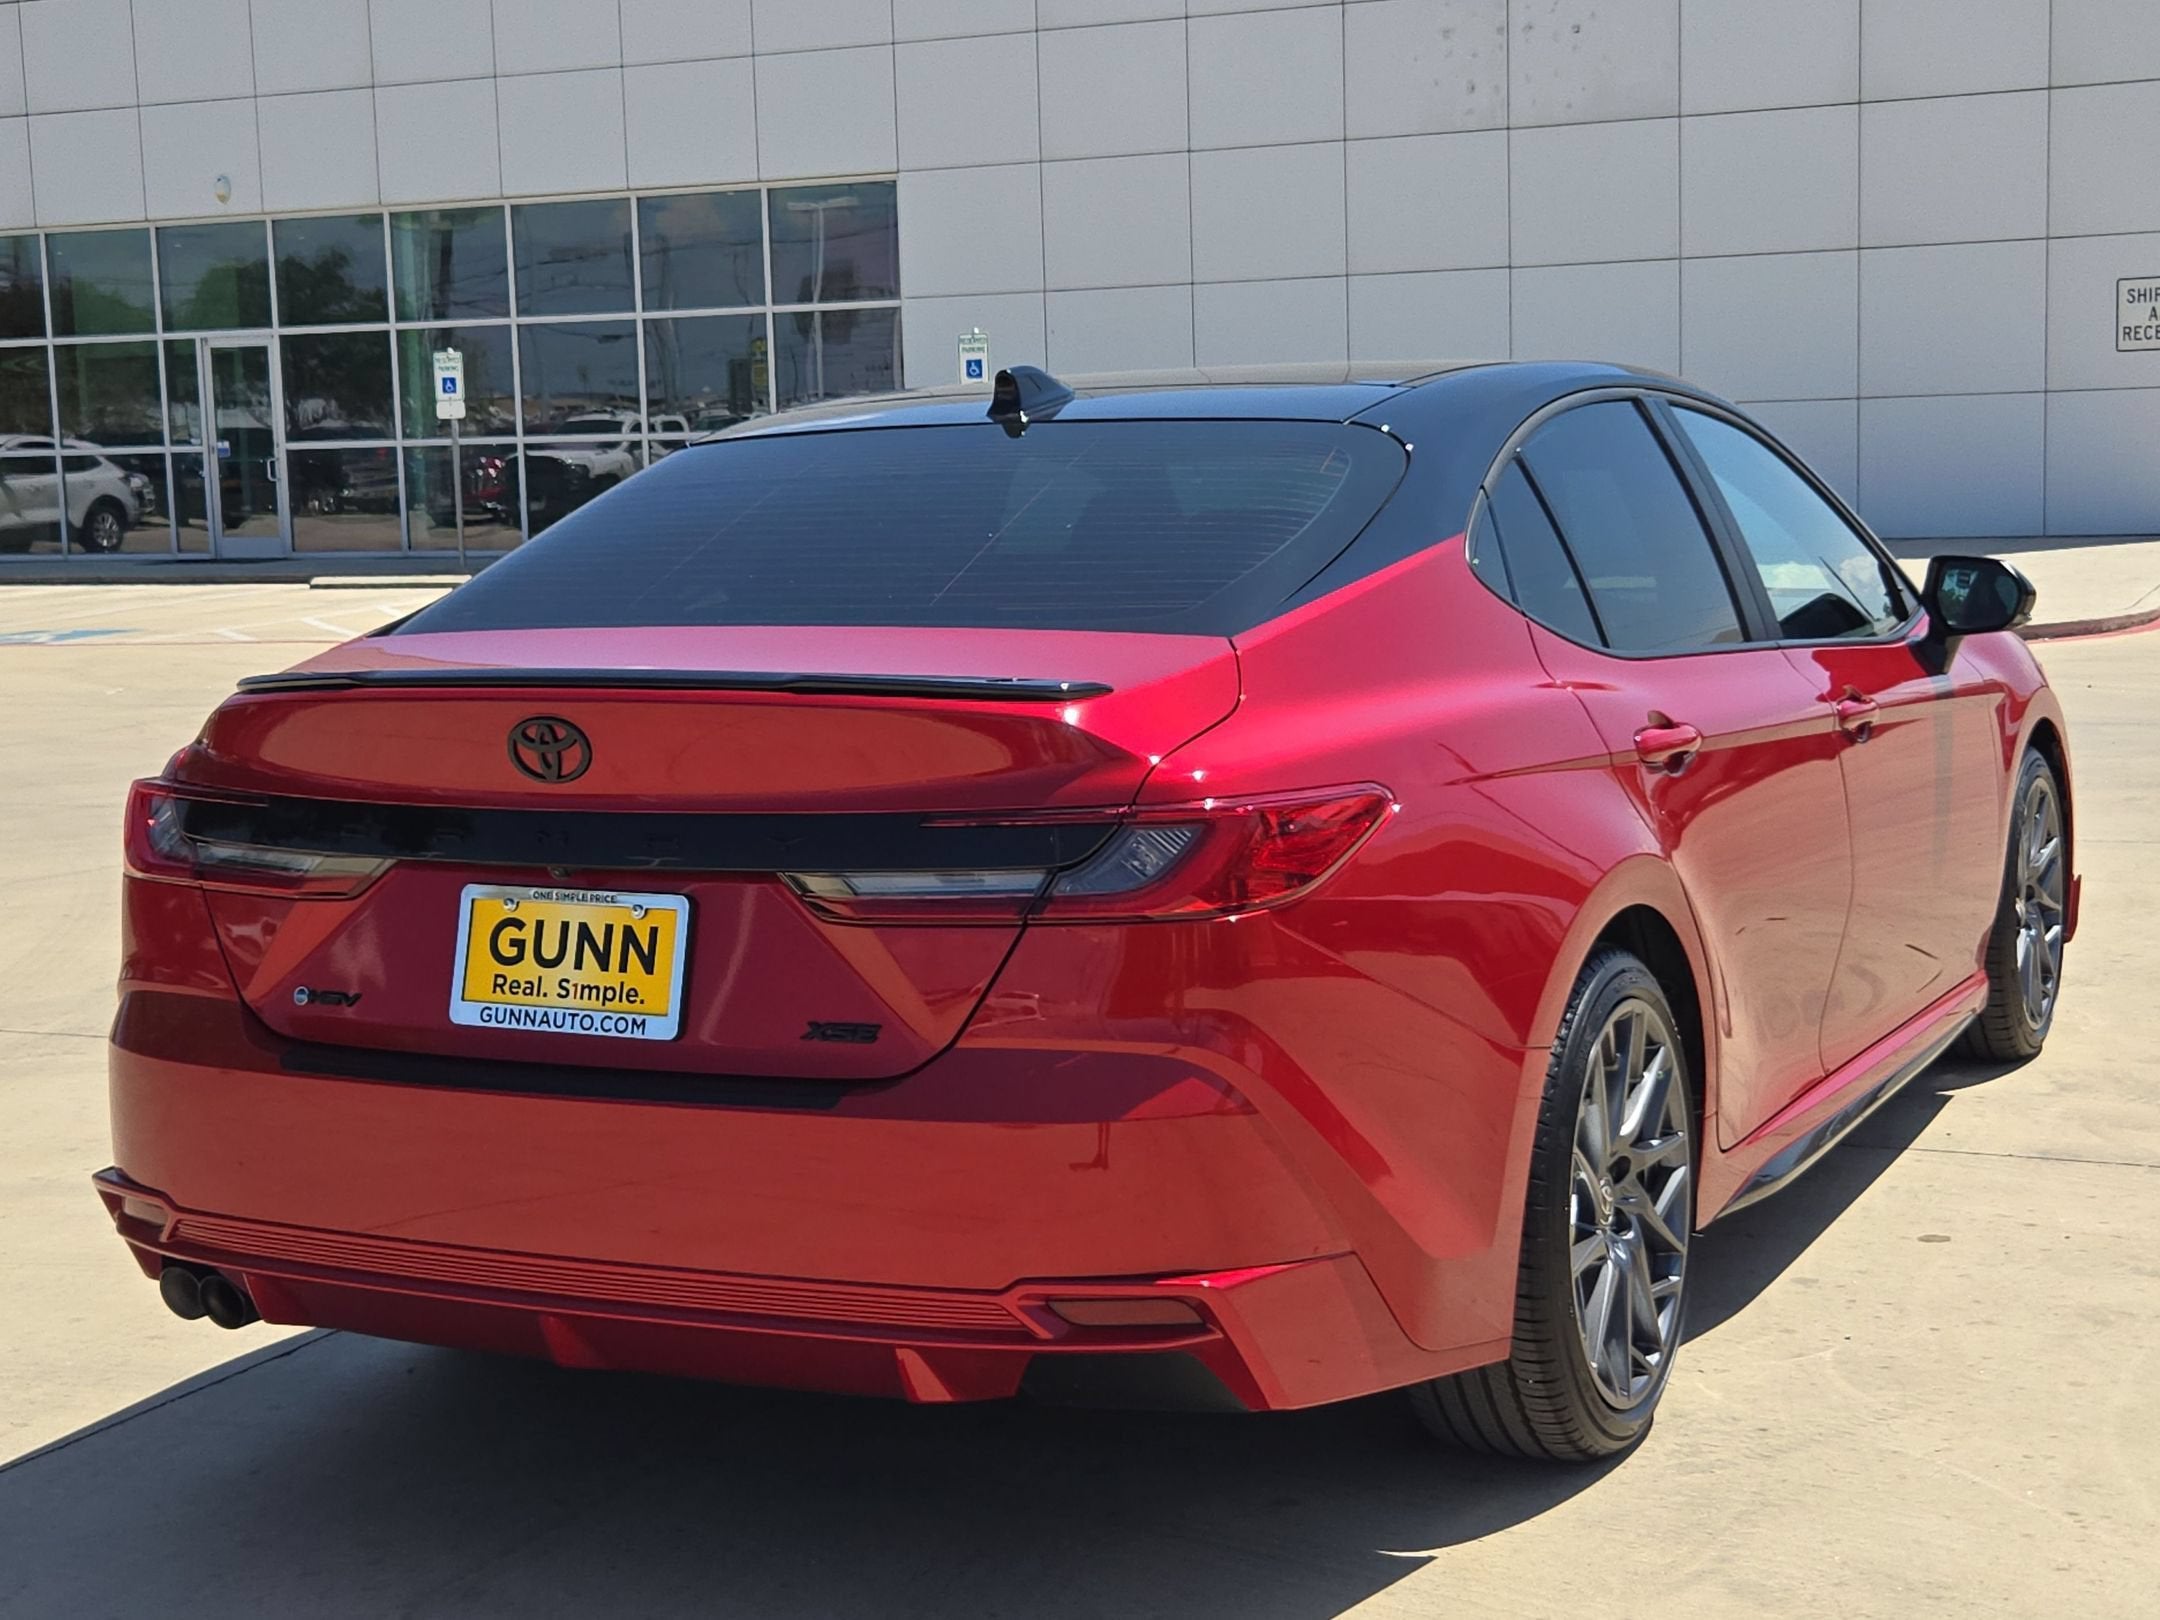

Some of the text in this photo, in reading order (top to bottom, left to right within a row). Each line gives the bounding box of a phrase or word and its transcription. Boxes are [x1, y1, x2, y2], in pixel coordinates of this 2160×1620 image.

[533, 890, 617, 904] ONE SIMPLE PRICE
[489, 917, 659, 975] GUNN
[492, 973, 547, 998] Real.
[480, 1006, 647, 1035] GUNNAUTO.COM
